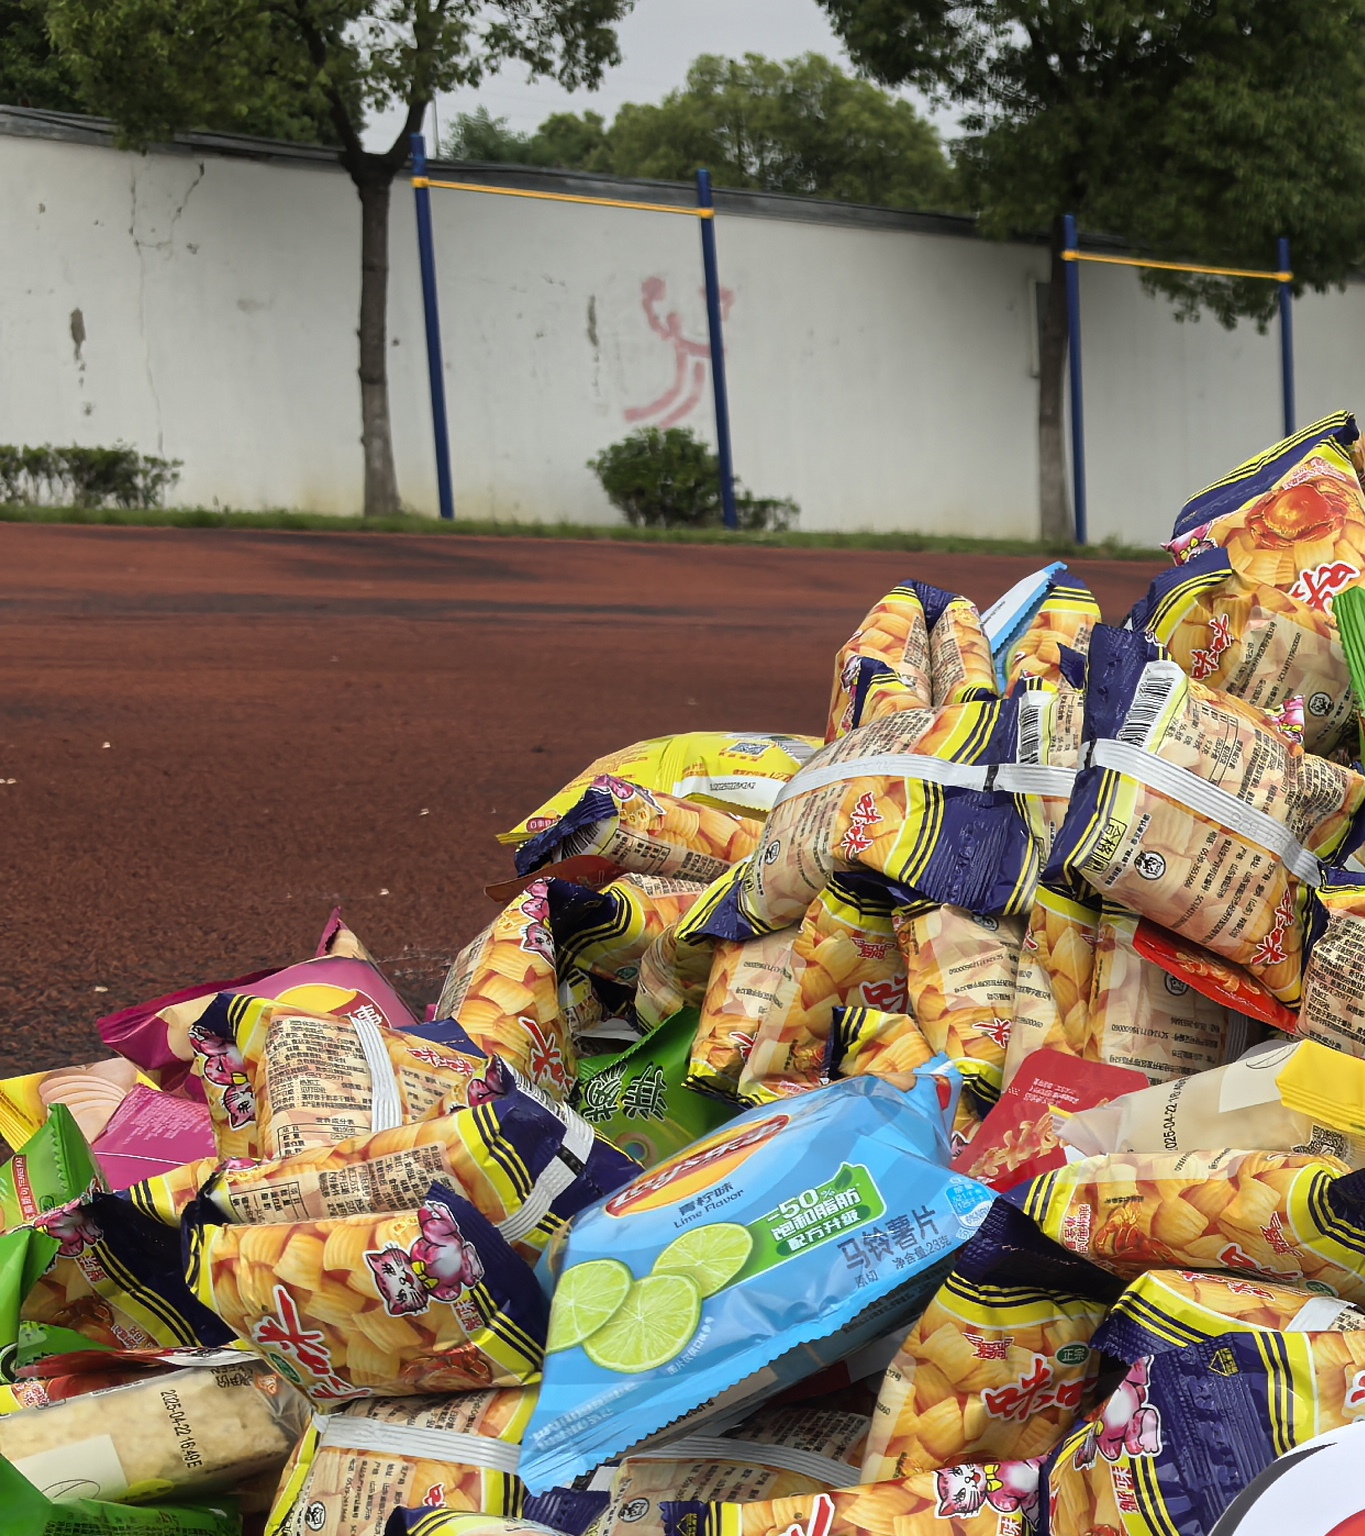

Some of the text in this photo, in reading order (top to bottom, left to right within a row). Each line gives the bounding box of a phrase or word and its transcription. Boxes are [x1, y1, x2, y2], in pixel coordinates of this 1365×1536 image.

[1093, 820, 1126, 857] 合格
[1163, 1103, 1178, 1151] 025-04-22
[763, 1178, 836, 1228] -50%
[769, 1184, 863, 1245] 饱和脂肪
[786, 1205, 862, 1255] 配方升级
[835, 1197, 945, 1279] 马铃薯片
